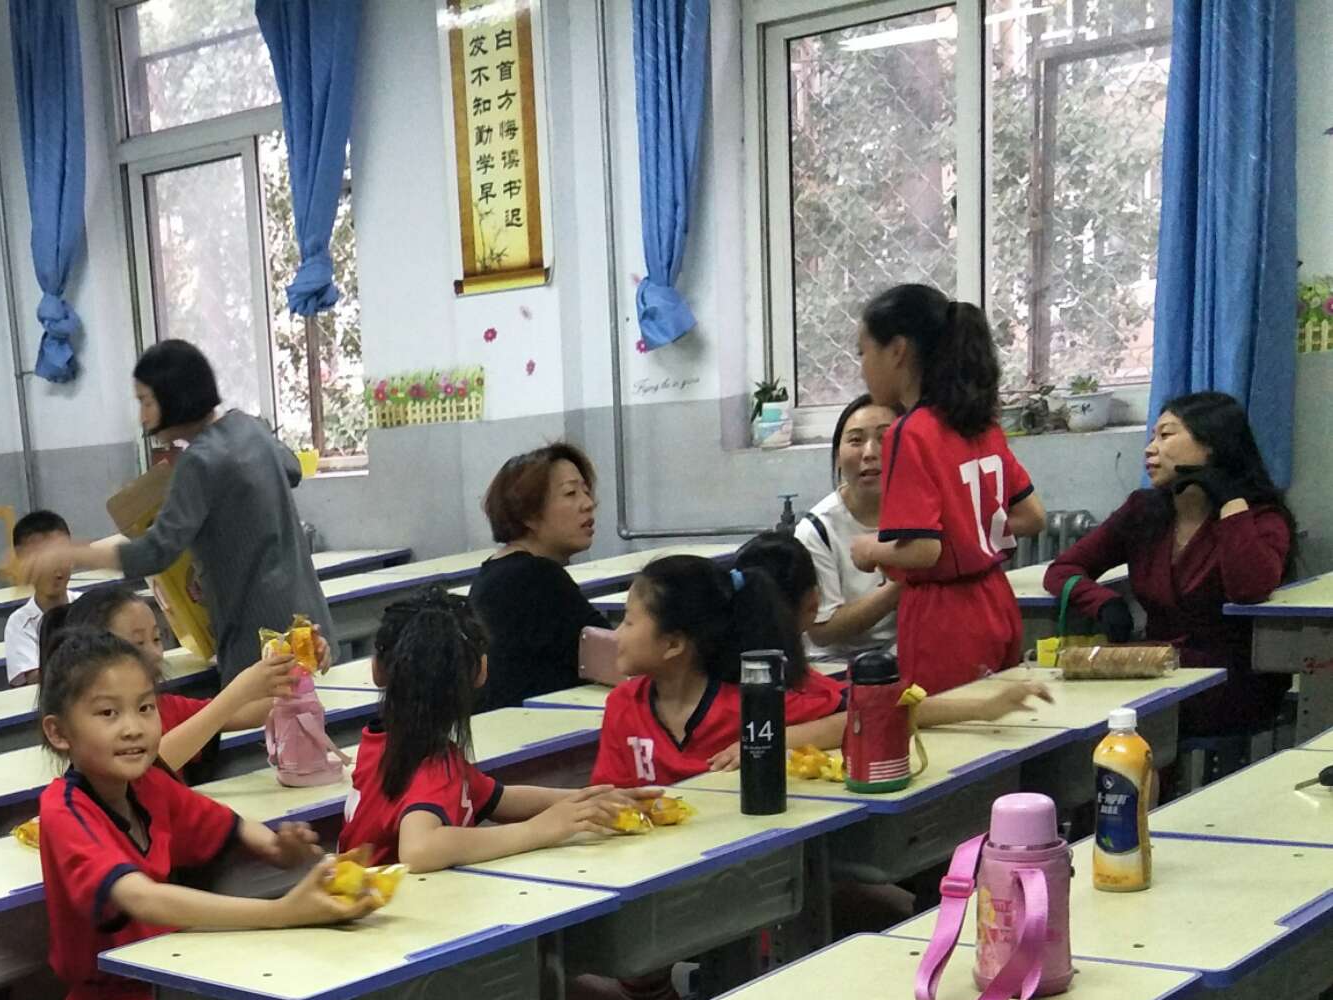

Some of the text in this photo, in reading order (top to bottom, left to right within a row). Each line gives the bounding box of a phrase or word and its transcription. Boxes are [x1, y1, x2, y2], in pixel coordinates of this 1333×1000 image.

[469, 4, 497, 205] 发不知勤学早
[494, 28, 523, 229] 白首方悔读书迟
[746, 720, 774, 742] 14
